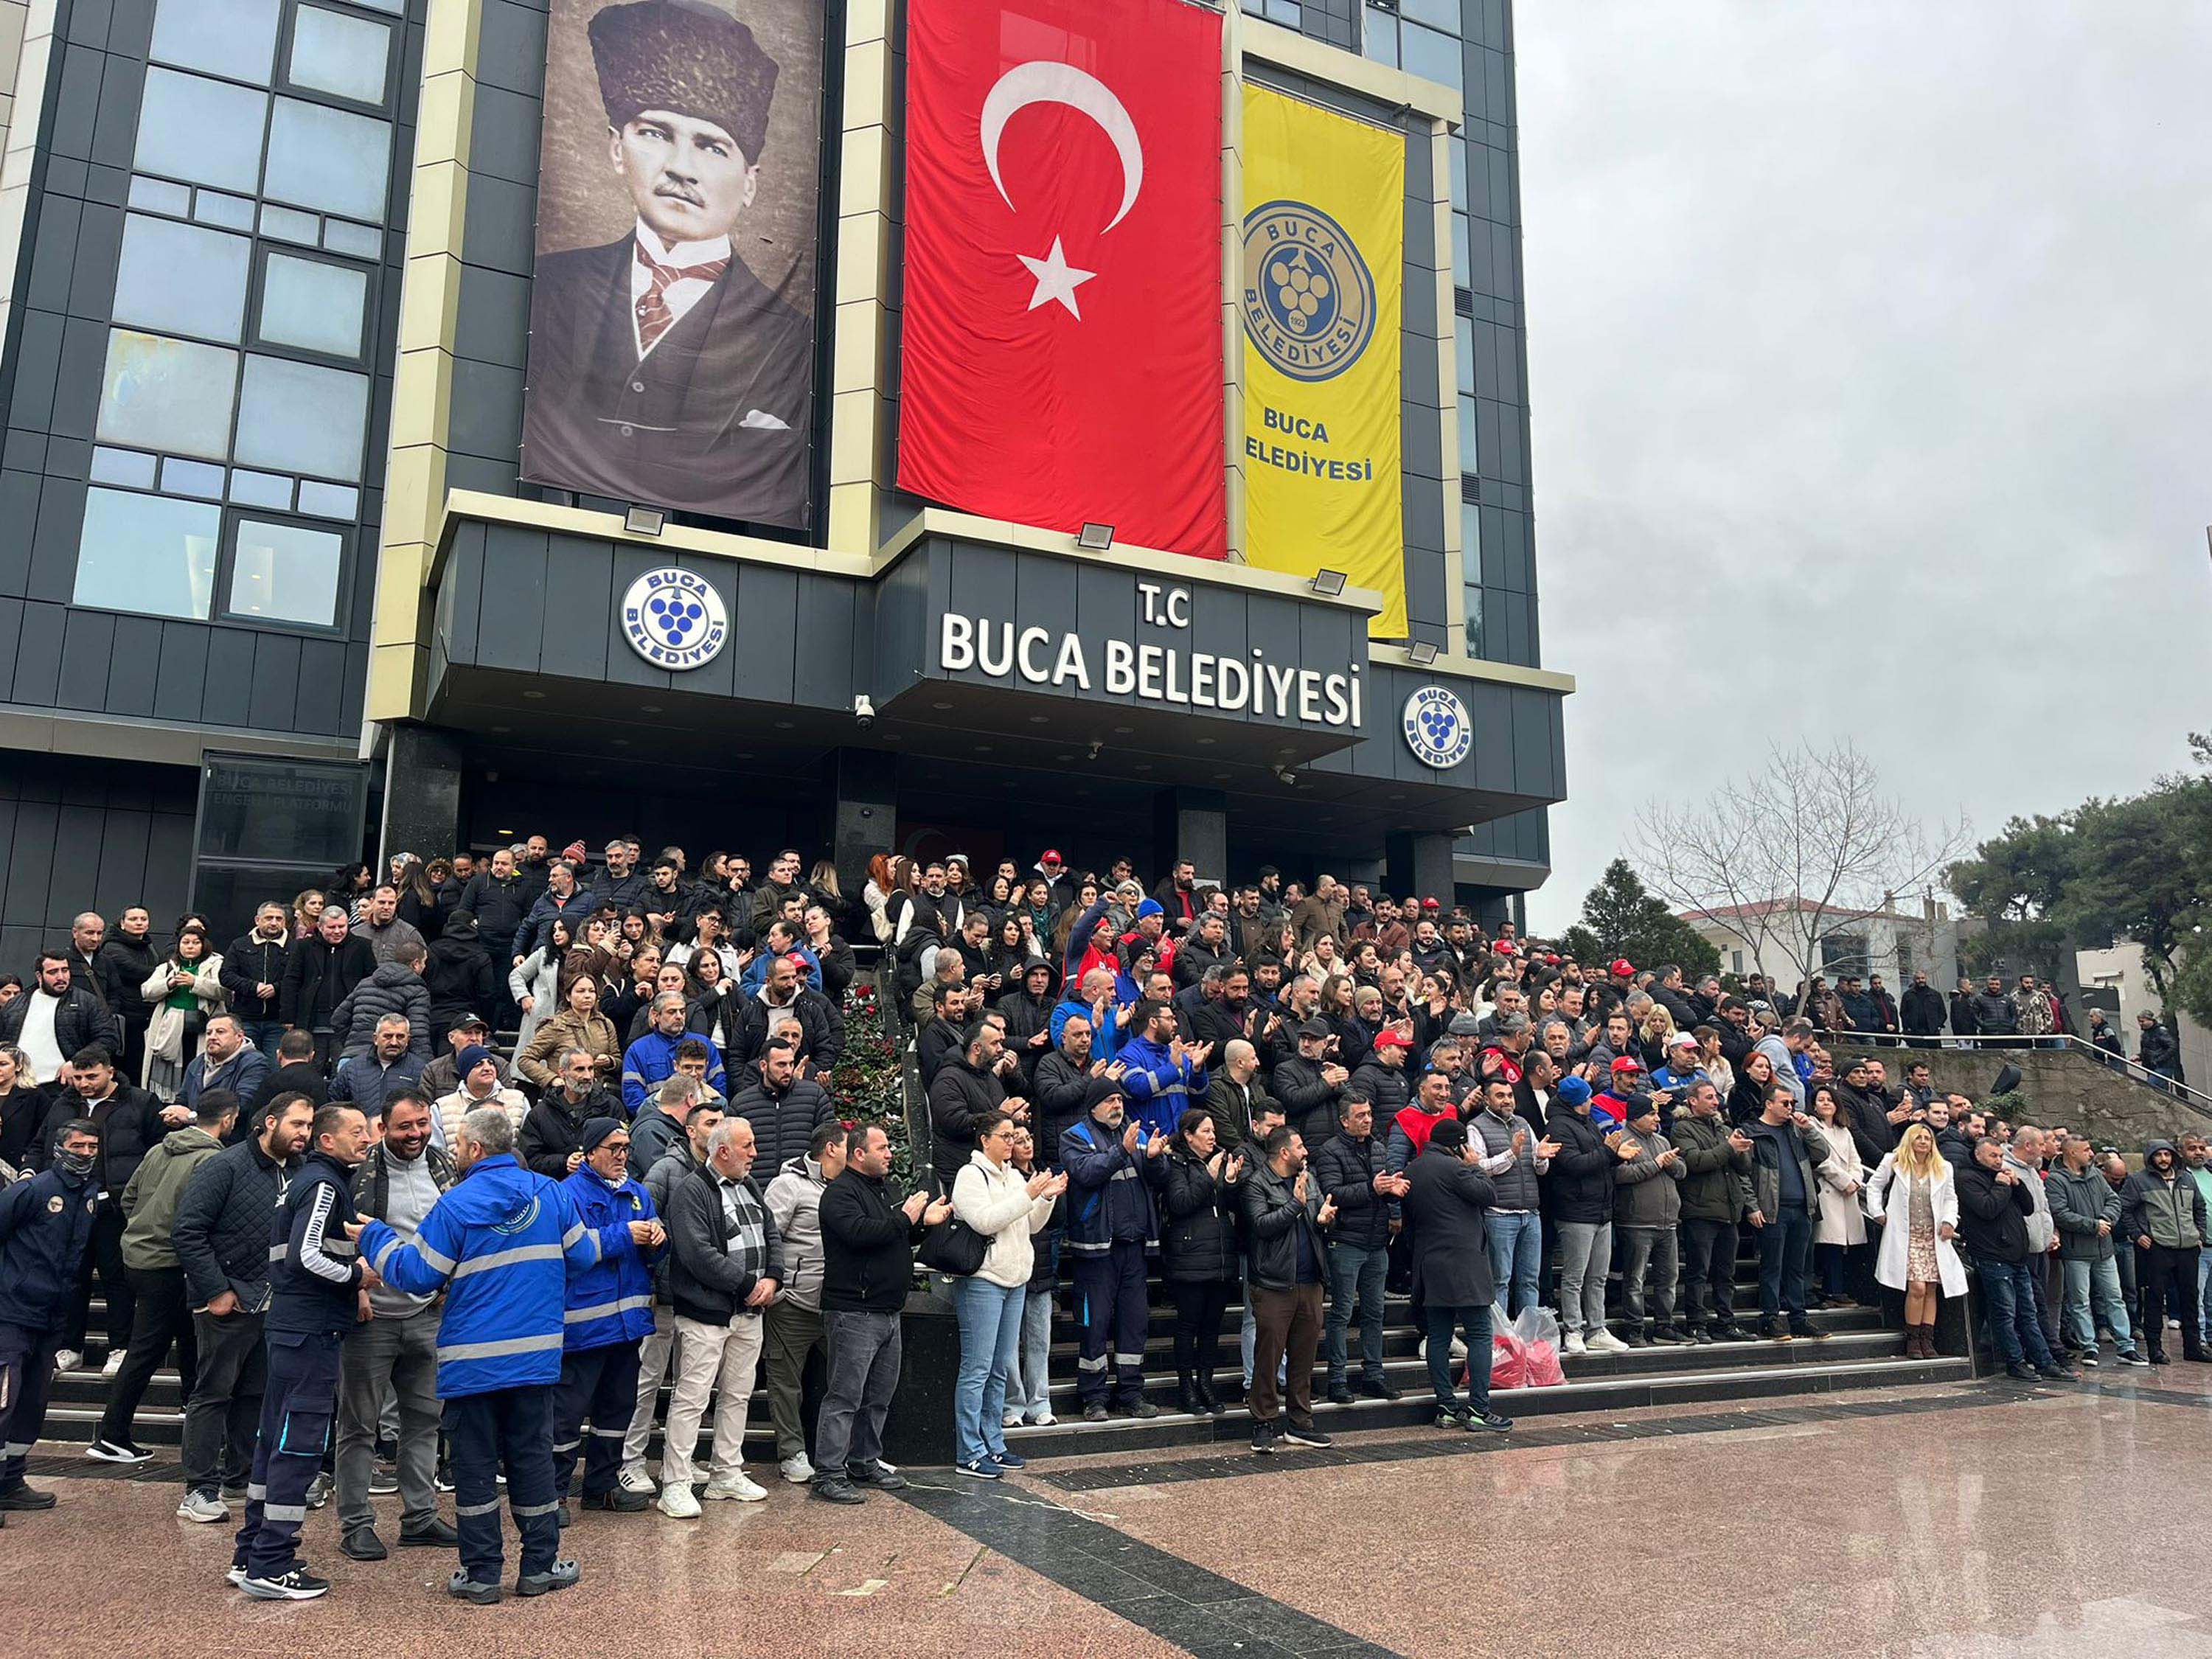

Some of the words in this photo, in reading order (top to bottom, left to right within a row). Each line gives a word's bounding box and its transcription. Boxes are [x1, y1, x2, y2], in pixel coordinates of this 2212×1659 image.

[1266, 220, 1335, 260] BUCA
[1244, 288, 1357, 364] BELEDİYESİ
[1264, 406, 1329, 443] BUCA
[1245, 435, 1372, 481] ELEDİYESİ
[647, 572, 707, 597] BUCA
[1138, 582, 1189, 628] T.C
[941, 613, 1091, 689] BUCA
[1106, 639, 1362, 727] BELEDİYESİ
[1417, 689, 1458, 709] BUCA
